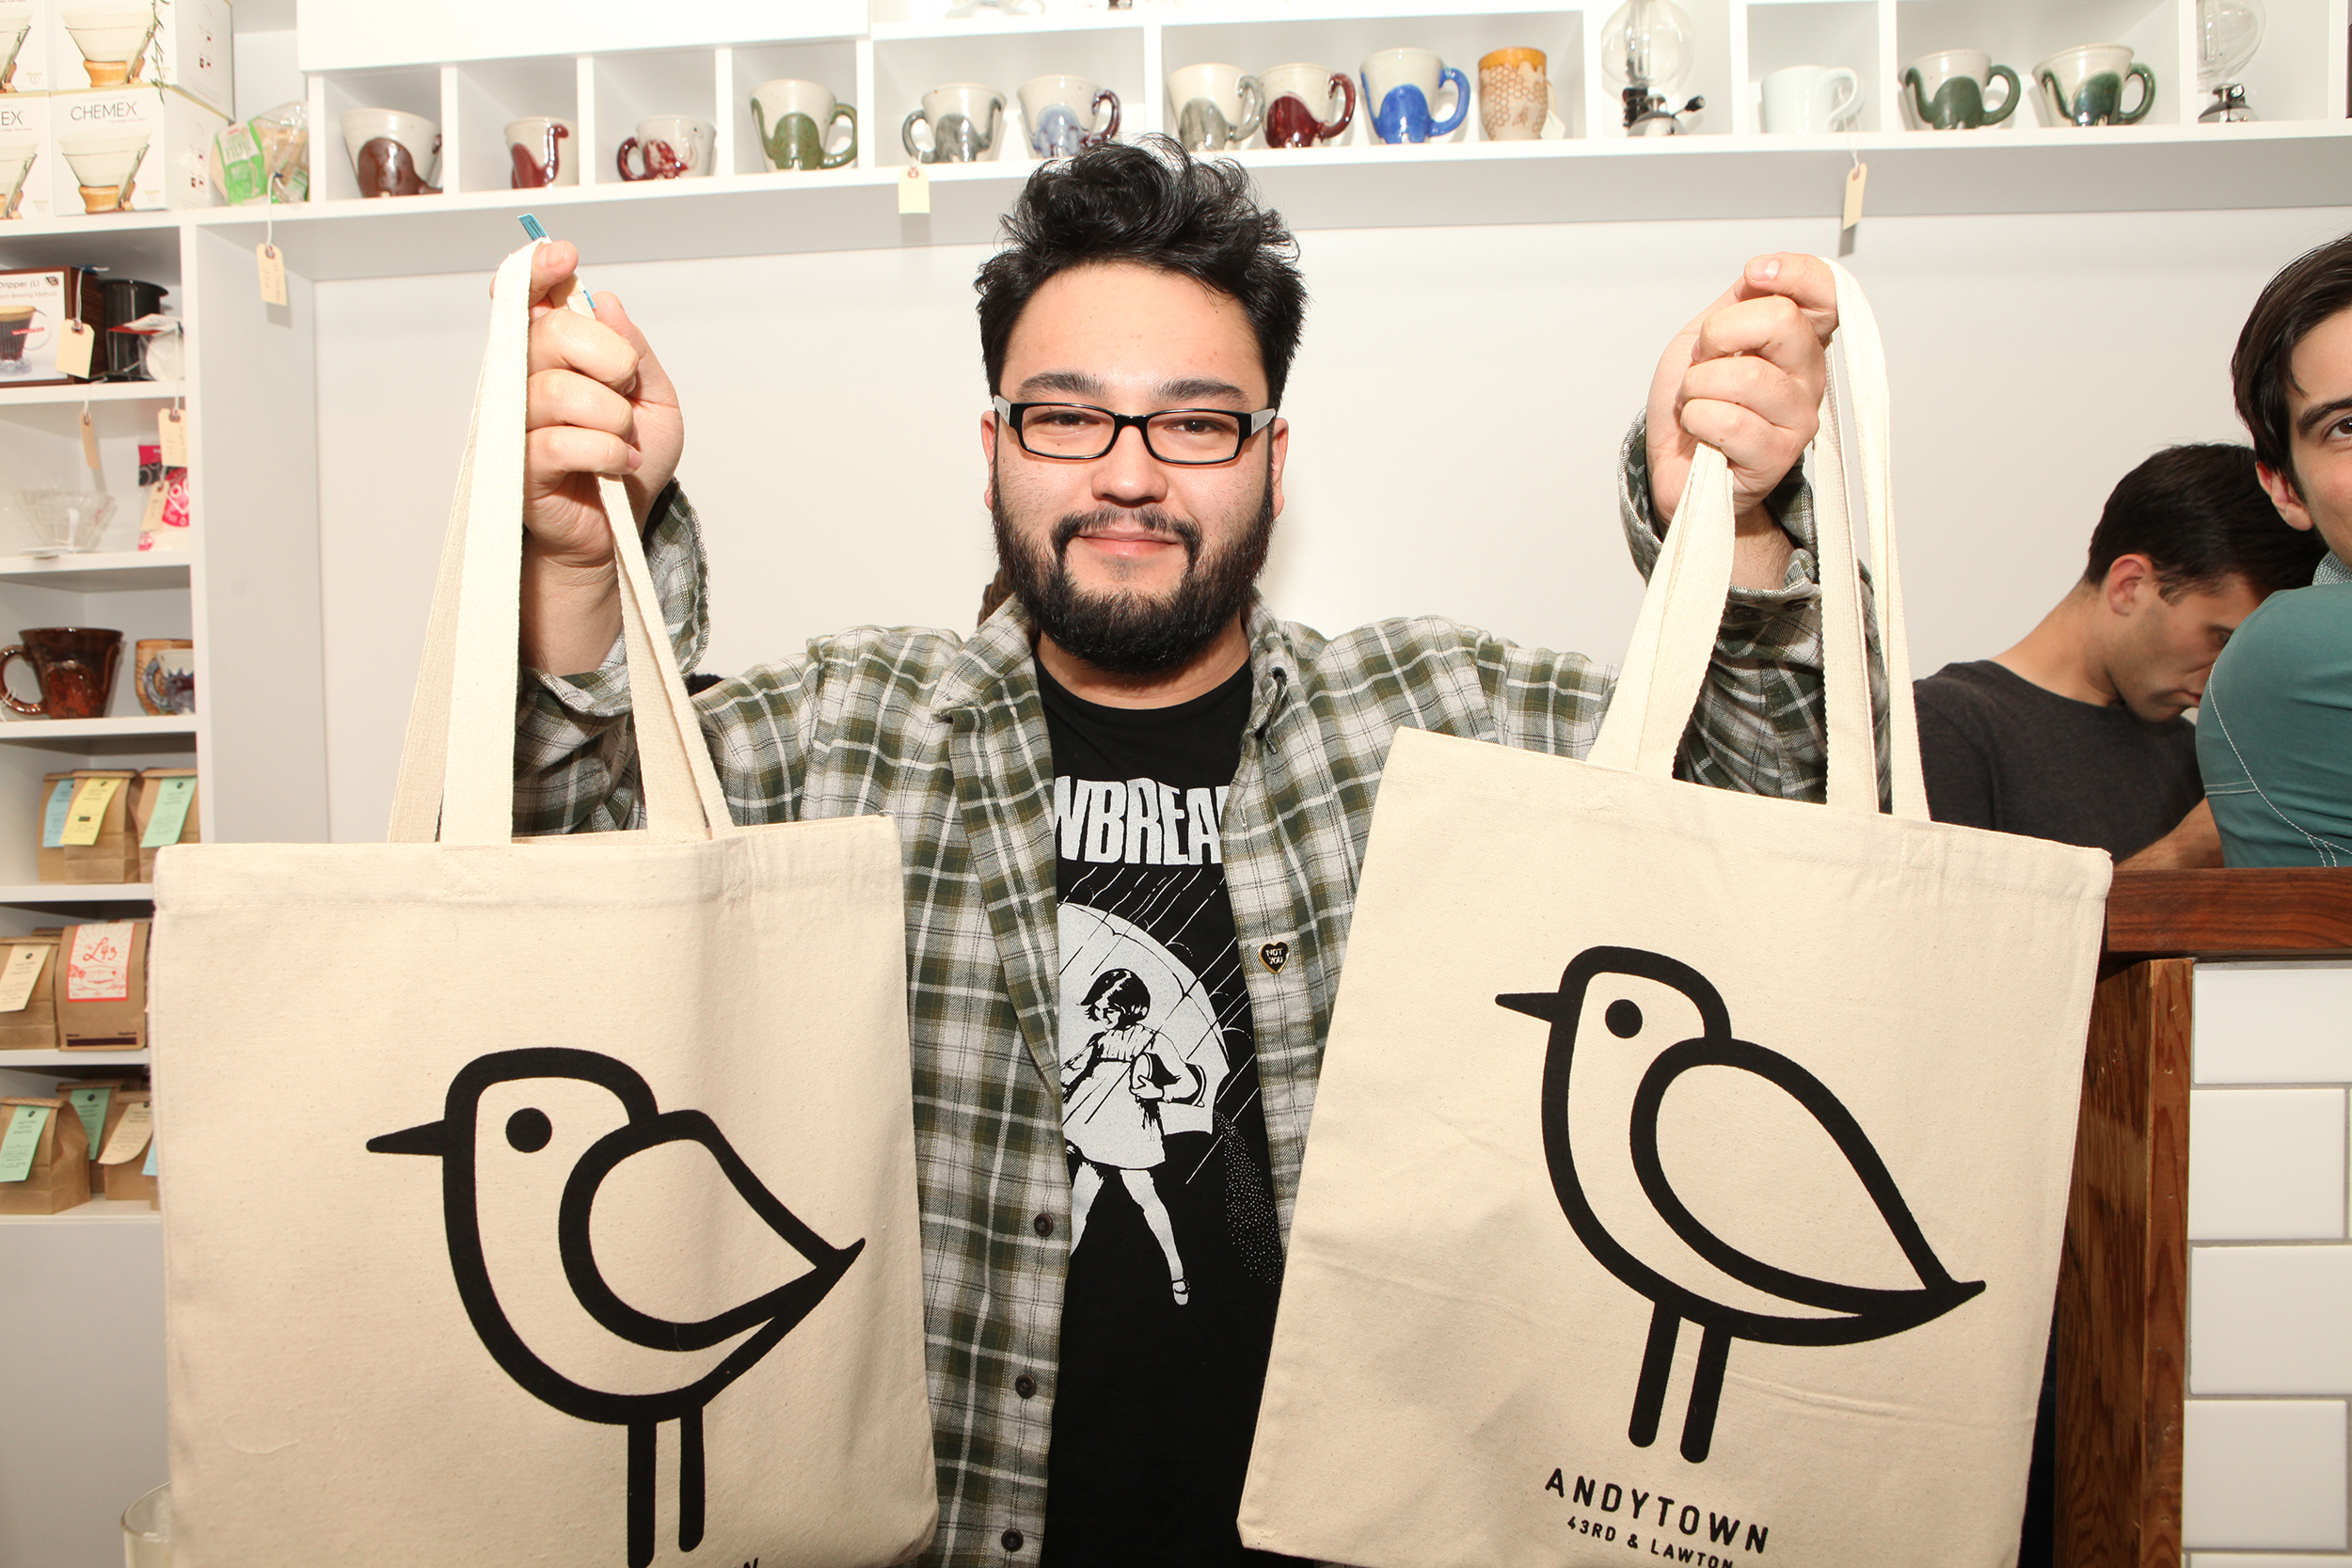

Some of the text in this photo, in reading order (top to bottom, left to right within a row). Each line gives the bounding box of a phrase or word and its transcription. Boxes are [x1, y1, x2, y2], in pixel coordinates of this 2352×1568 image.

[71, 101, 137, 121] CHEMEX
[1265, 947, 1283, 957] NOT
[1268, 956, 1283, 965] YOU
[1544, 1467, 1769, 1554] ANDYTOWN
[1566, 1515, 1734, 1568] 43RD & LAWTON
